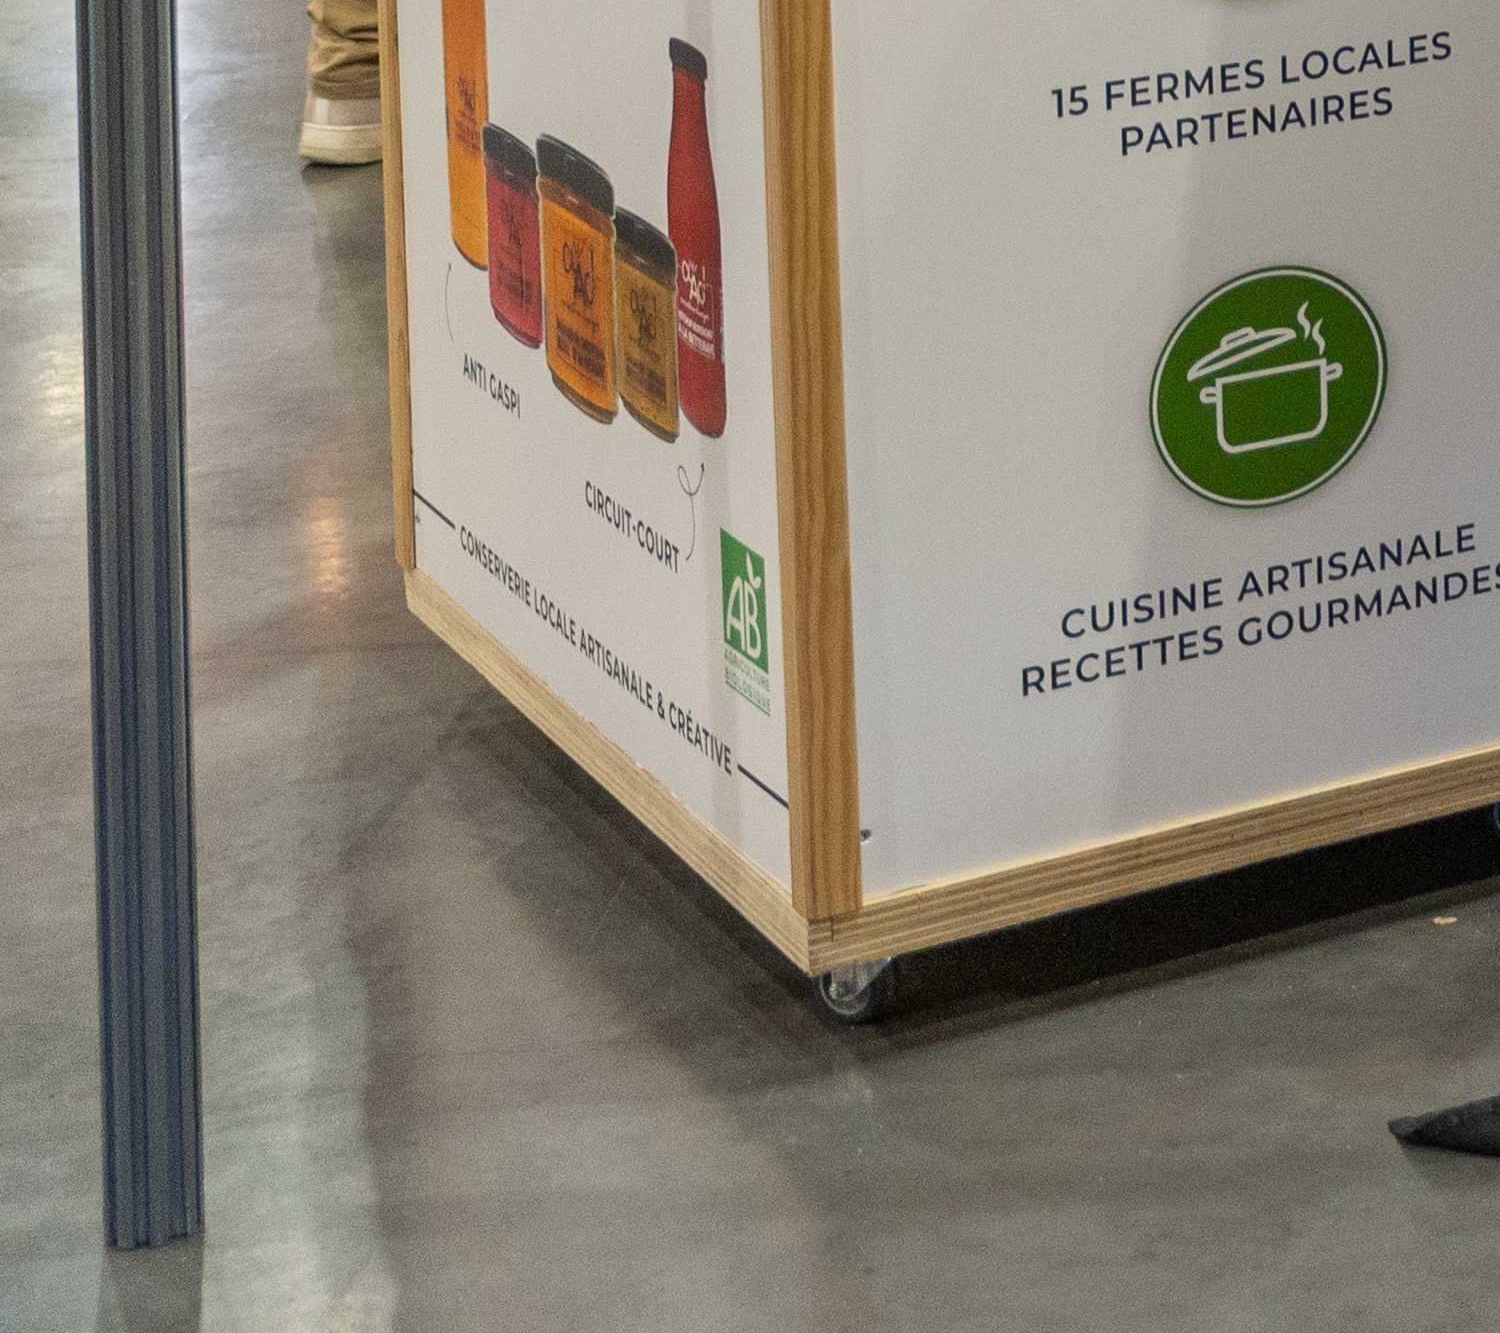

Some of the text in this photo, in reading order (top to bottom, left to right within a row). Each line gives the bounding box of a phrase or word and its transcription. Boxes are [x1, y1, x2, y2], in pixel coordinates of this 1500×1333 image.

[1051, 31, 1454, 119] 15 FERMES LOCALES
[1120, 86, 1395, 157] PARTENAIRES
[462, 353, 521, 420] ANTI GASPI
[584, 480, 680, 574] CIRCUIT-COURT
[725, 573, 763, 659] AB
[1059, 523, 1478, 639] CUISINE ARTISANALE
[459, 524, 733, 776] CONSERVERIE LOCALE ARTISANALE & CRÉATIVE
[724, 648, 771, 694] AGRICULTURE
[724, 664, 771, 714] BIOLOGIQUE
[1020, 626, 1225, 697] RECETTES
